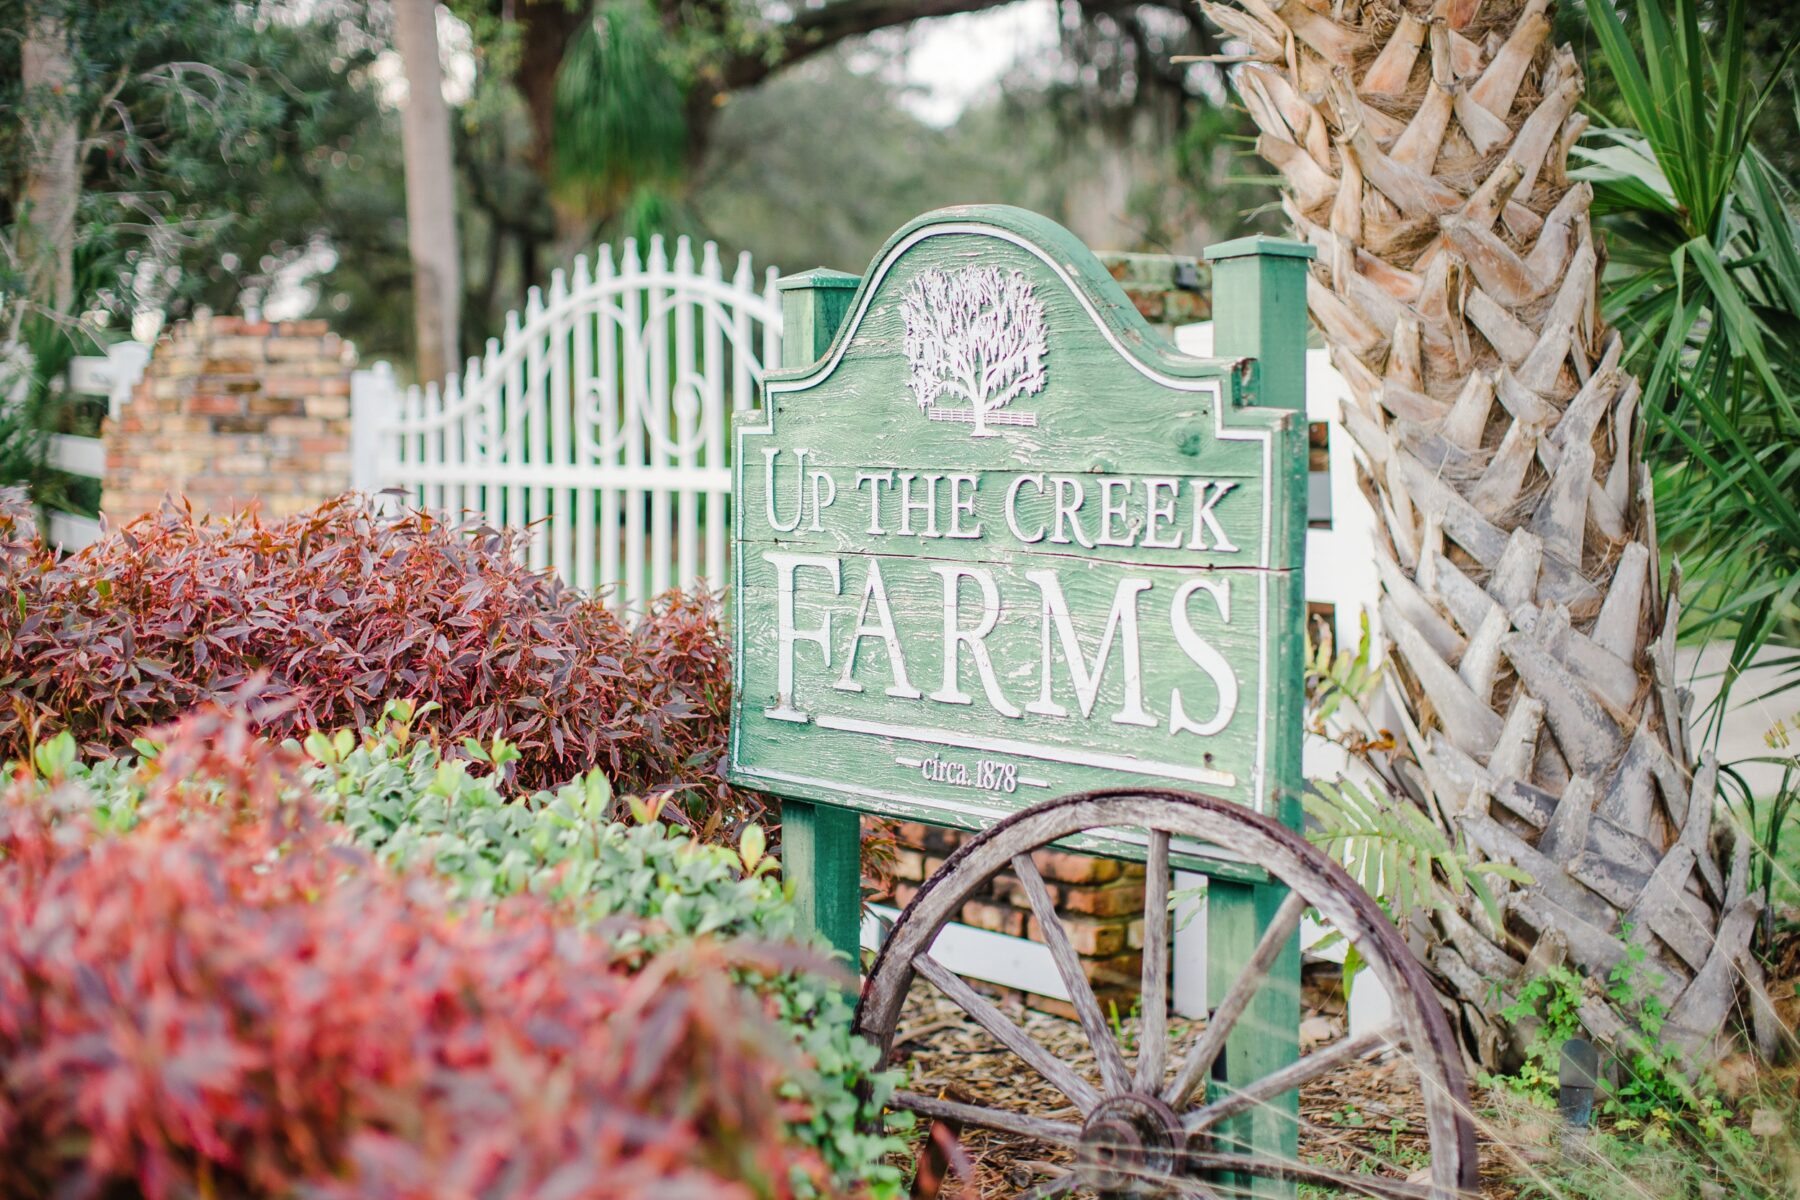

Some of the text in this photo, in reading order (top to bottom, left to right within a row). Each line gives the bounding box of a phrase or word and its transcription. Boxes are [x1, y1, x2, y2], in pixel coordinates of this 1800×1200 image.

[856, 470, 983, 539] THE
[1004, 472, 1240, 553] CREEK
[763, 551, 1238, 736] FARMS
[922, 752, 1017, 793] circa. 1878
